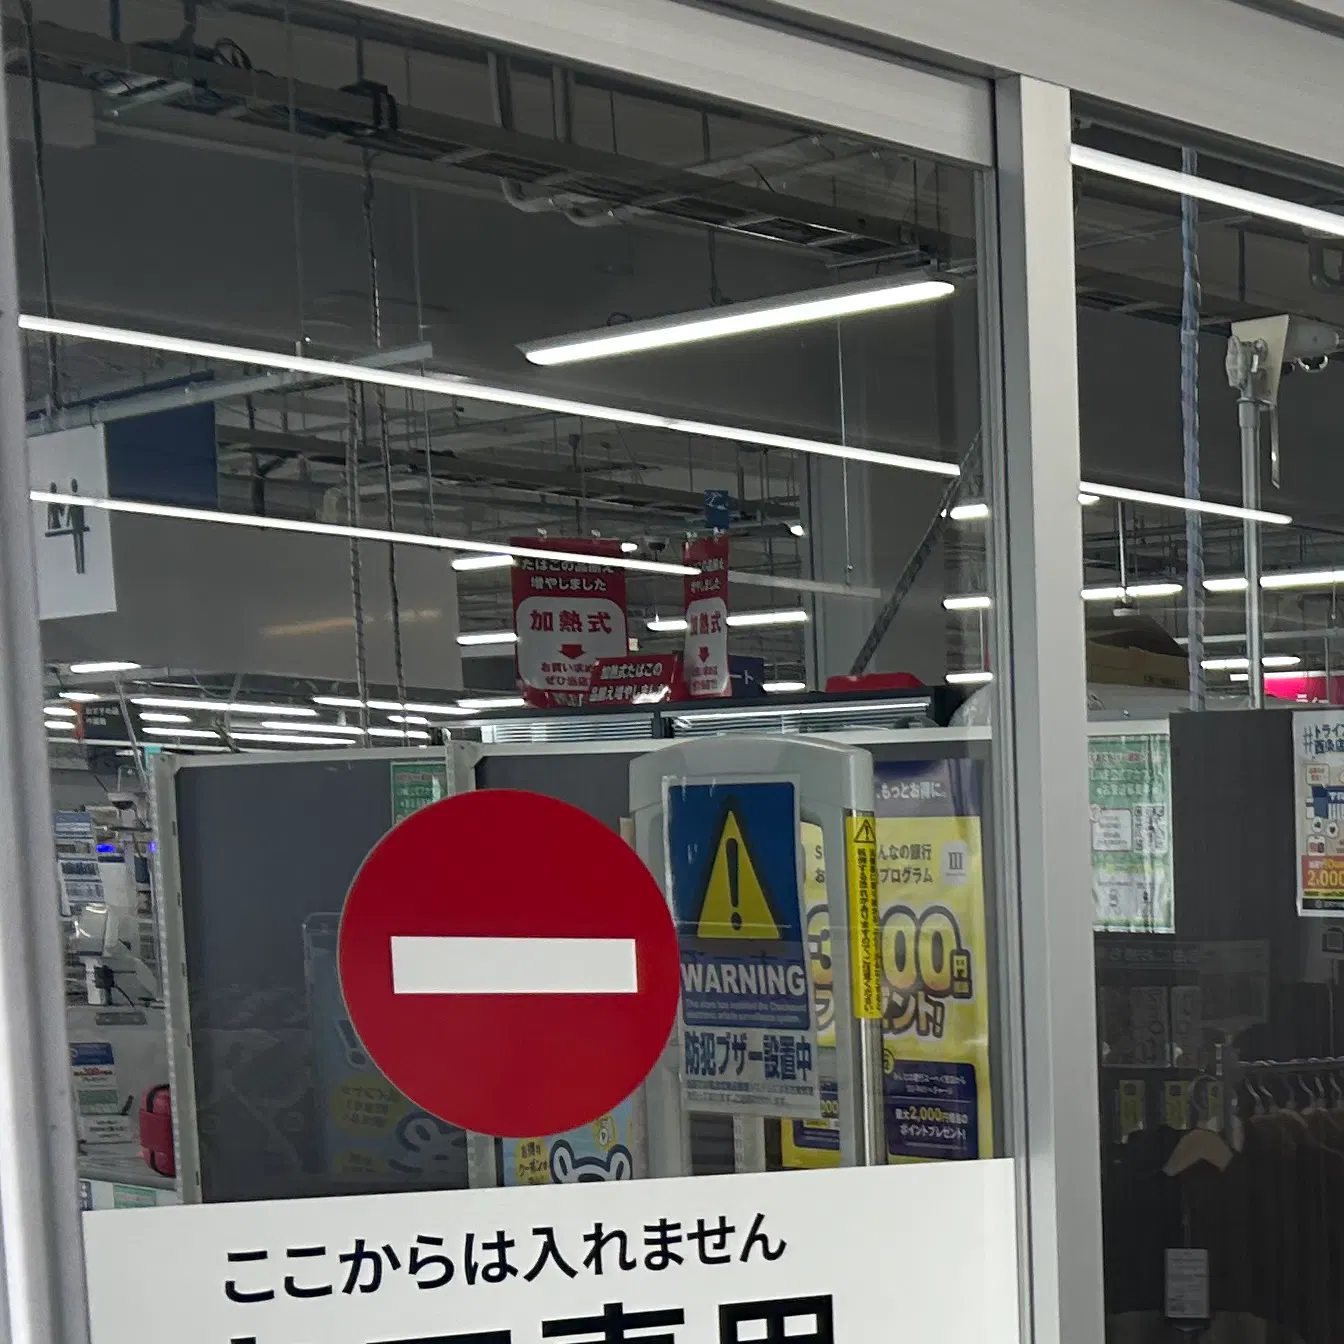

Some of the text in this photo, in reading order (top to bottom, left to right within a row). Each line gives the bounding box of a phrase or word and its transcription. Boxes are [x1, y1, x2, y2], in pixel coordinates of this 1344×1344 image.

[530, 575, 607, 592] 増やしました
[529, 609, 613, 634] 加熱式
[681, 962, 806, 997] WARNING
[684, 1030, 812, 1082] 防犯ブザー設置中
[223, 1211, 789, 1305] ここからは入れません
